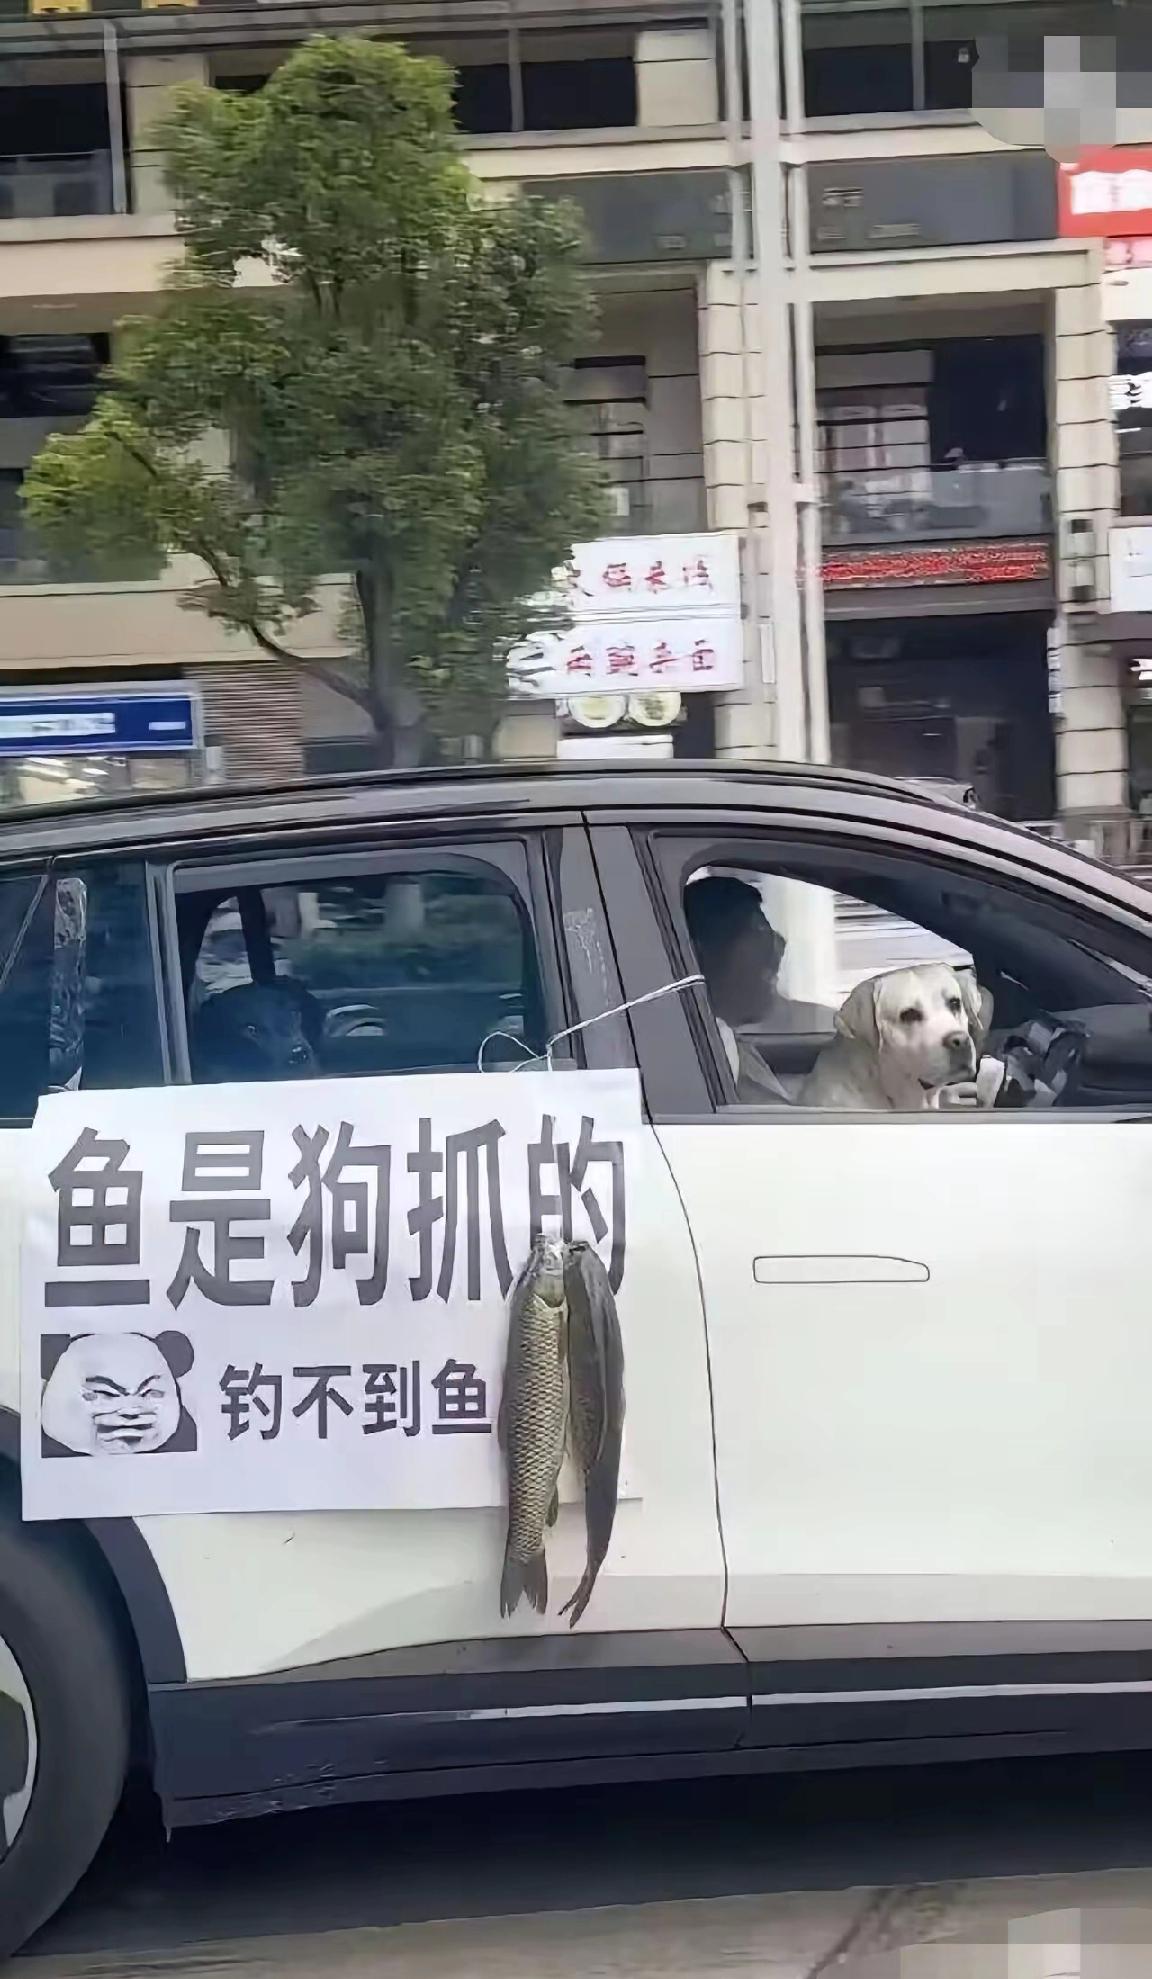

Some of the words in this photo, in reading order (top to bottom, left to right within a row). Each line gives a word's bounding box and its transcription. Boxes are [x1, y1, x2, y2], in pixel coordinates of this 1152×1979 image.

[45, 1114, 625, 1308] 鱼是狗抓的
[219, 1358, 493, 1440] 钓不到鱼
